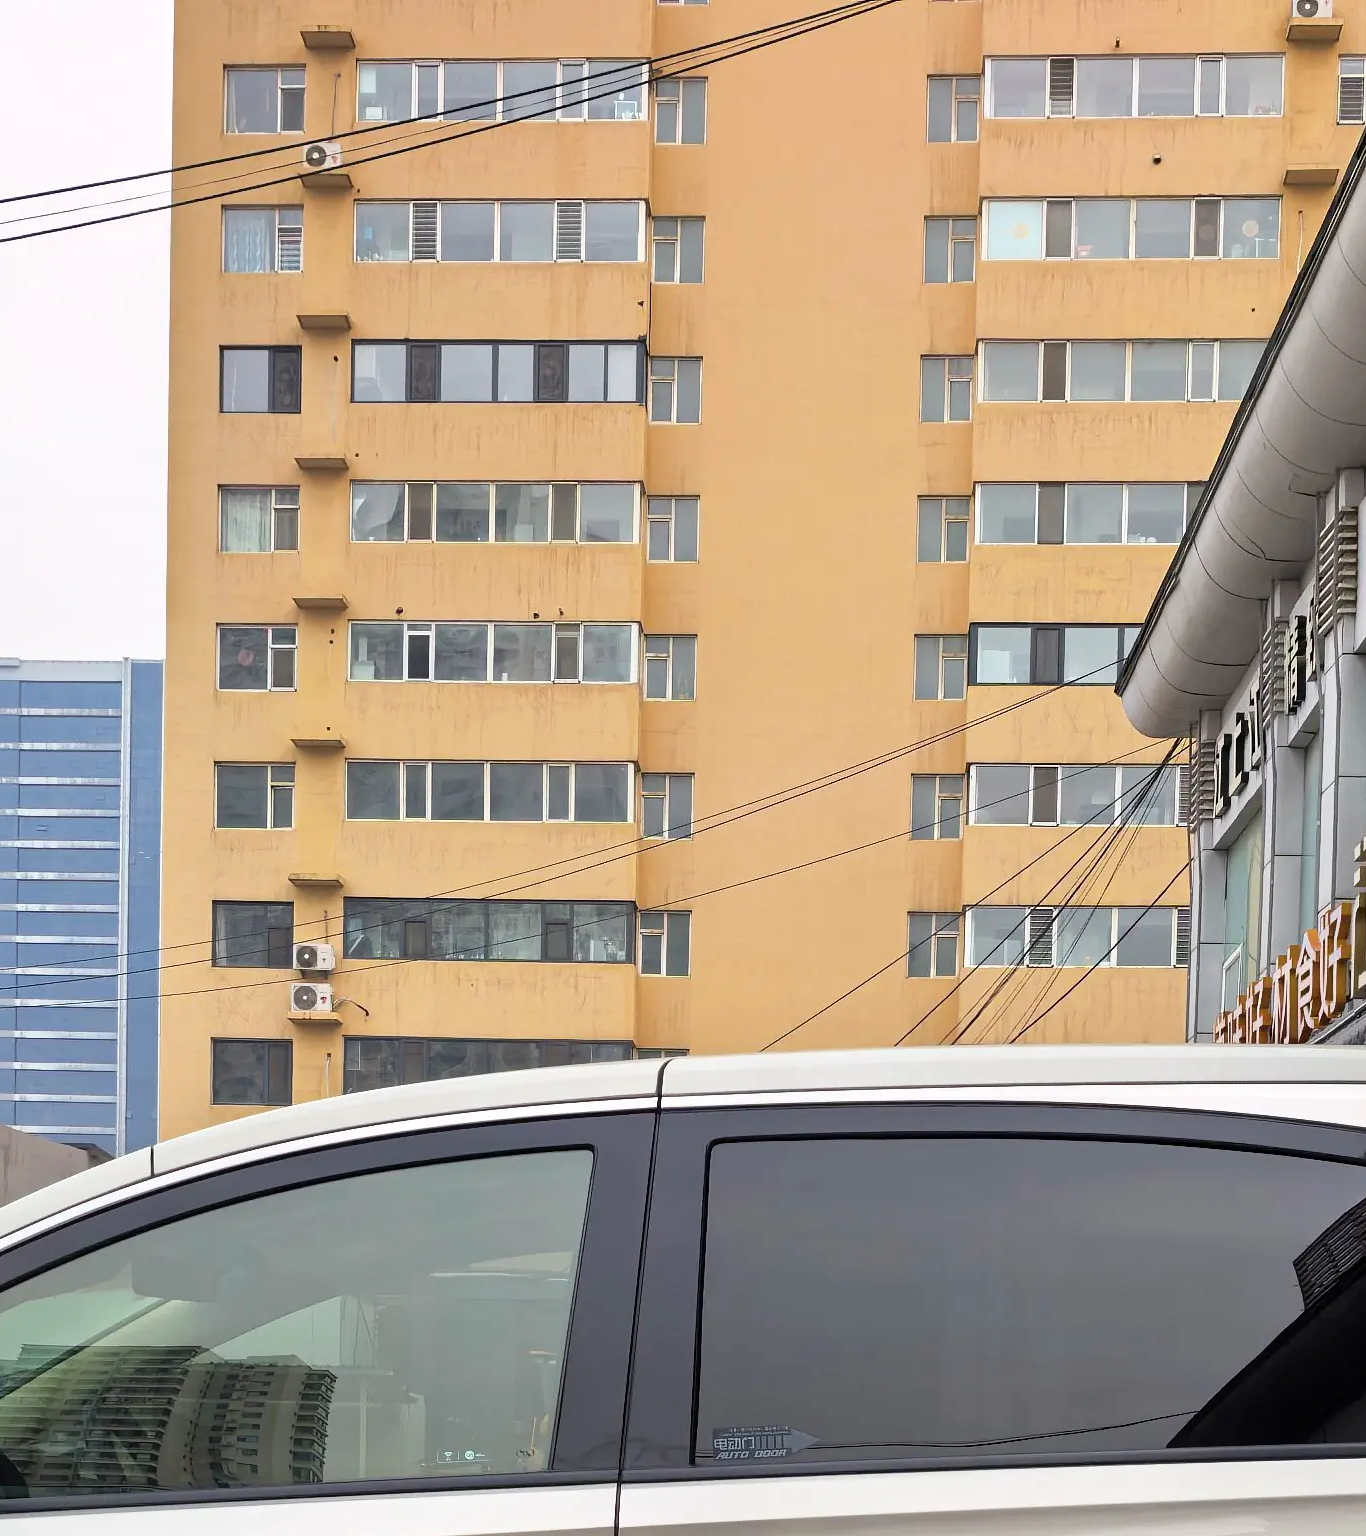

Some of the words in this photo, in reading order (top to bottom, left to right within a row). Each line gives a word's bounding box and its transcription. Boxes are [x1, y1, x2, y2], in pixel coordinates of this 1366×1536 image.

[713, 1436, 755, 1450] 电动门
[715, 1450, 750, 1460] AUTO
[753, 1448, 788, 1459] DOOR
